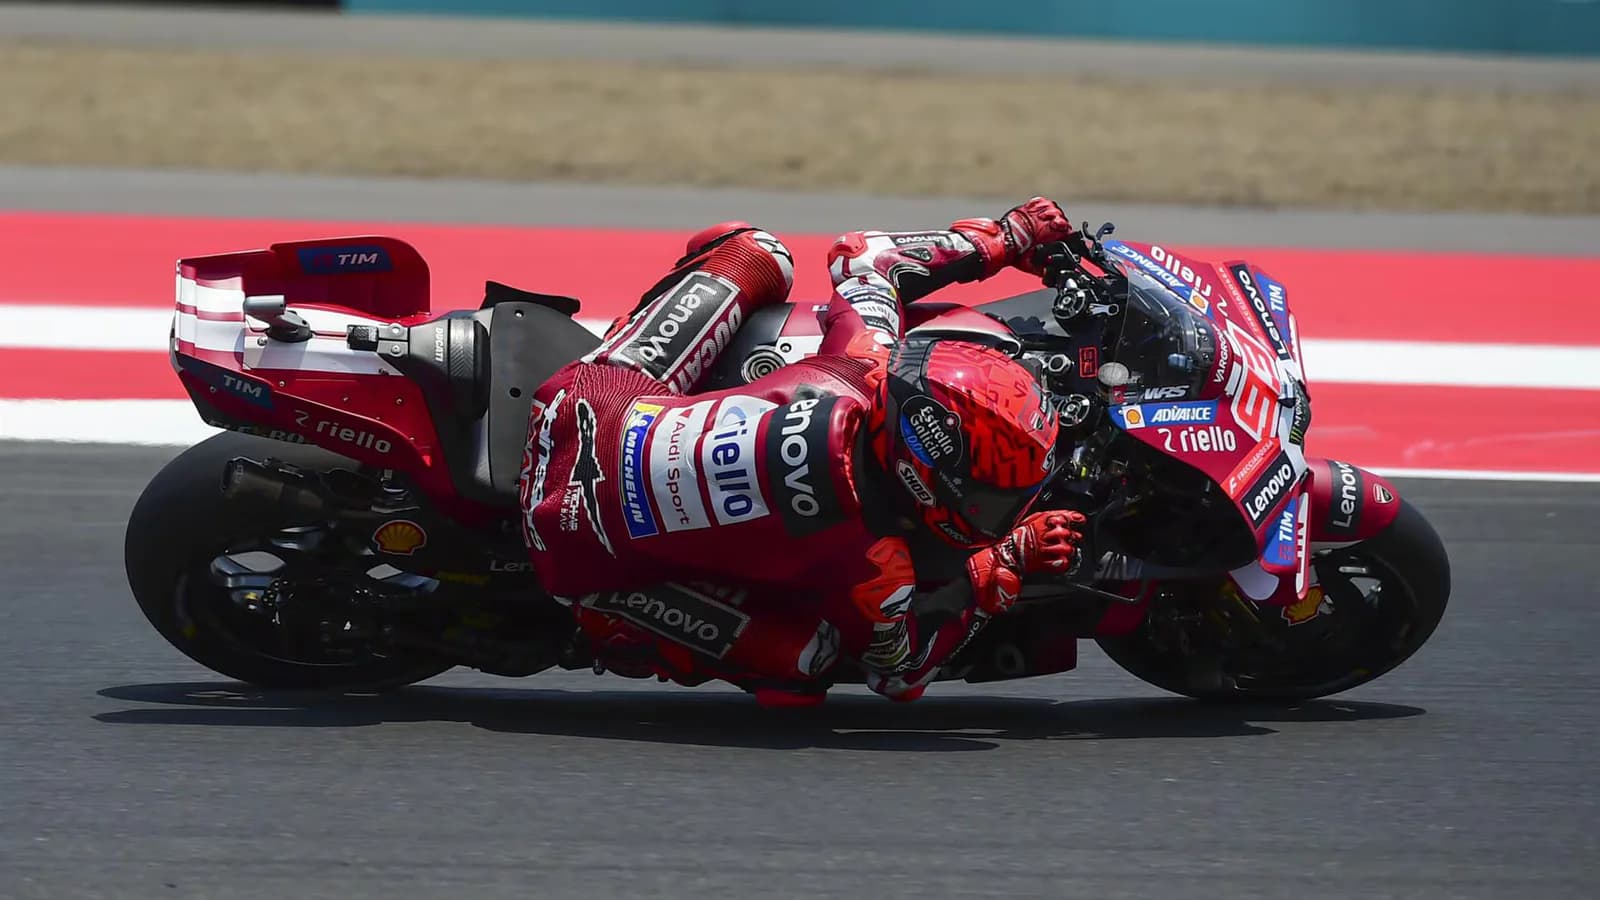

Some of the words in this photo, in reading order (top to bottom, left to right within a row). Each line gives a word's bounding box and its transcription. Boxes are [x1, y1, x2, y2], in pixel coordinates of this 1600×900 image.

[337, 252, 379, 265] TIM
[1112, 245, 1185, 288] ADVANCE
[1151, 246, 1211, 297] riello
[1238, 269, 1288, 356] Lenovo
[1269, 284, 1284, 312] TIM
[638, 282, 718, 362] Lenovo
[434, 327, 445, 363] DUCATI
[223, 373, 264, 398] TIM
[1144, 384, 1190, 400] WRS
[919, 405, 955, 456] Estrella
[1151, 404, 1211, 424] ADVANCE
[315, 420, 392, 453] riello
[667, 421, 685, 462] Audi
[781, 397, 820, 517] enovo
[909, 412, 941, 461] Galicia
[1180, 425, 1237, 452] riello
[623, 430, 646, 525] MICHELIN
[711, 421, 754, 518] iello
[900, 467, 932, 502] SHOEI
[666, 467, 690, 525] Sport
[1245, 463, 1293, 521] Lenovo
[1331, 461, 1354, 528] Lenov
[1278, 510, 1294, 541] TIM
